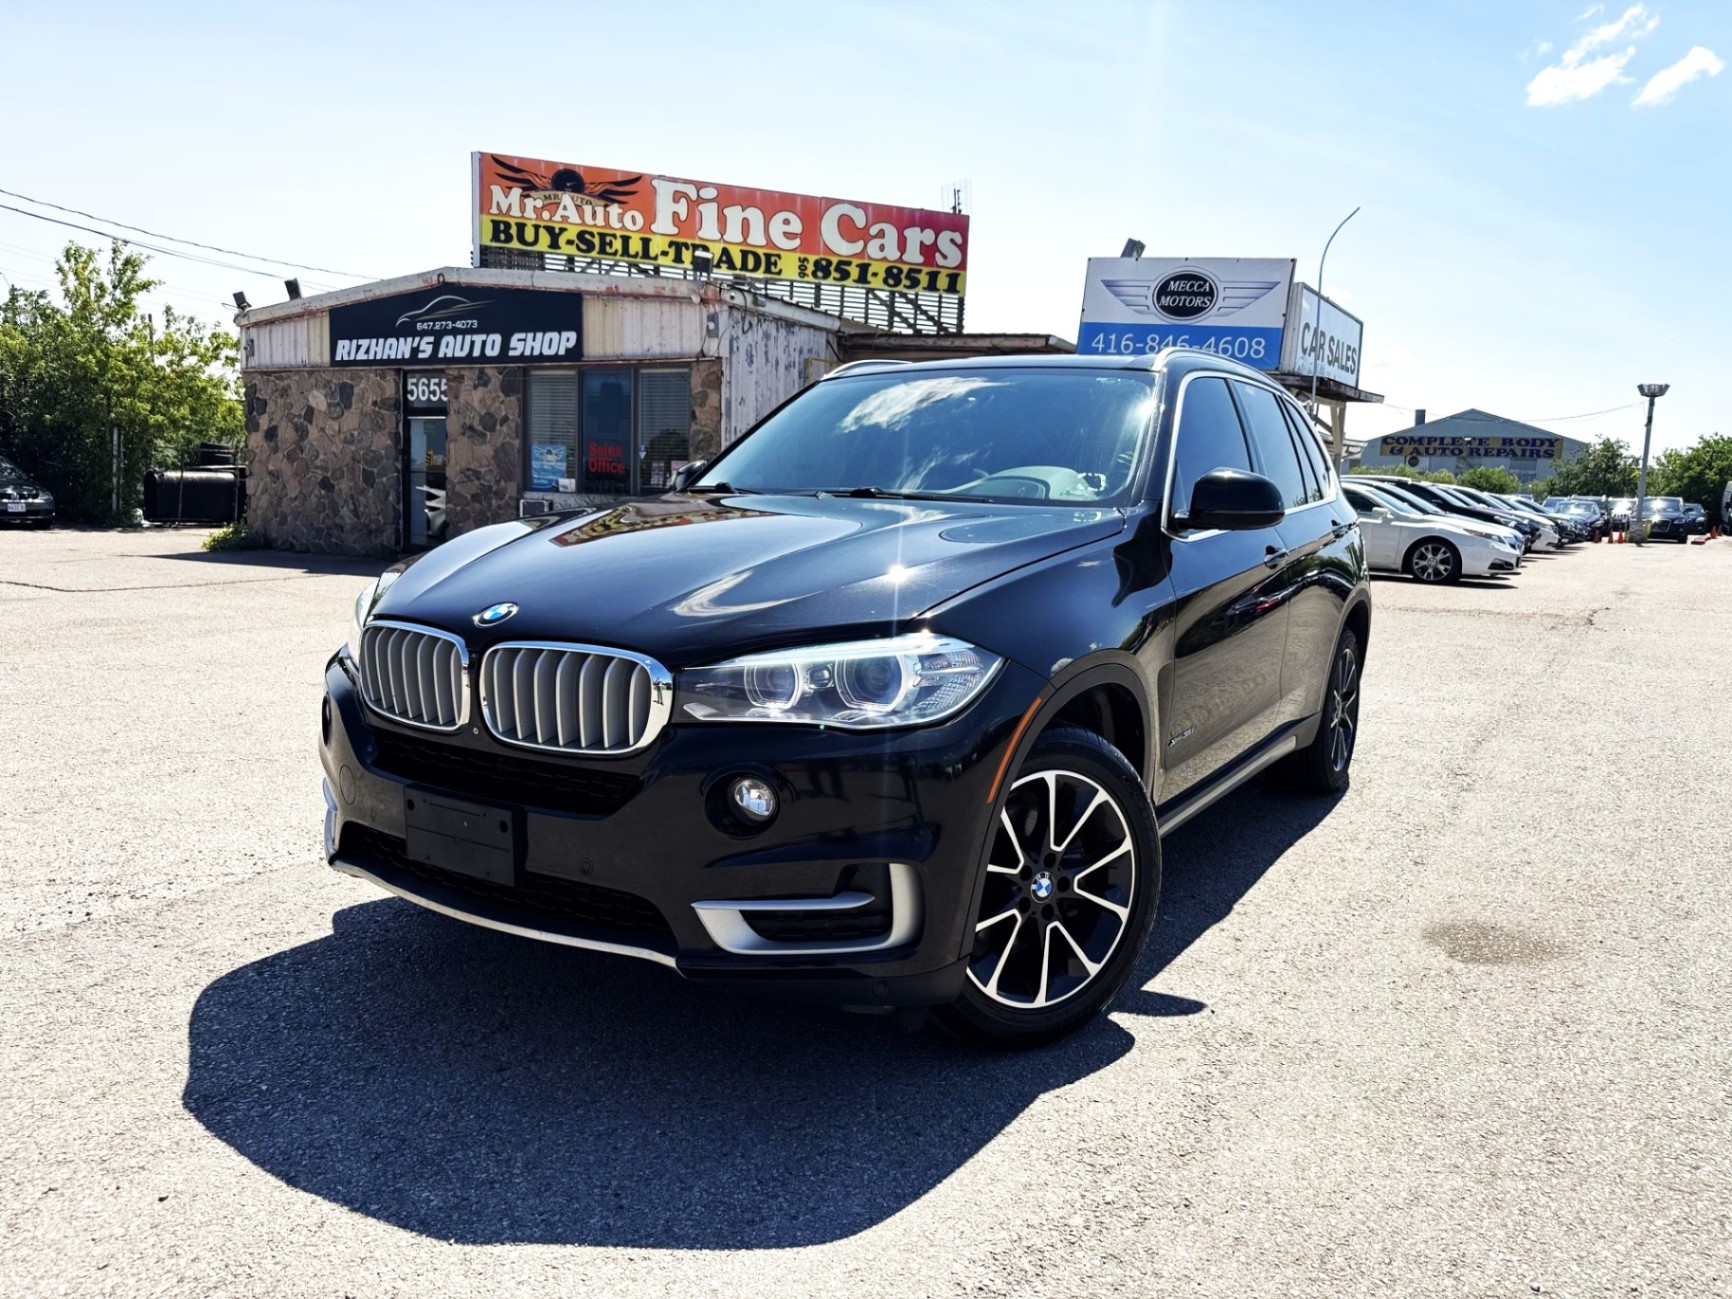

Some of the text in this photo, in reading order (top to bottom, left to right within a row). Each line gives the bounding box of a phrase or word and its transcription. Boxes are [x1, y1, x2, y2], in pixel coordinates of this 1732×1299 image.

[488, 178, 963, 268] Mr.Auto Fine Cars
[811, 256, 962, 295] 851-8511
[1167, 280, 1210, 293] MECCA
[1158, 294, 1212, 308] MOTORS
[335, 331, 577, 361] RIZHAN'S AUTO SHOP
[1091, 332, 1266, 360] 416-846-4608
[1301, 322, 1357, 375] CAR SALES
[406, 377, 449, 401] 5655
[588, 441, 624, 458] Sales
[1389, 446, 1555, 459] & AUTO REPAIRS
[1501, 437, 1559, 448] BODY
[588, 458, 625, 474] Office
